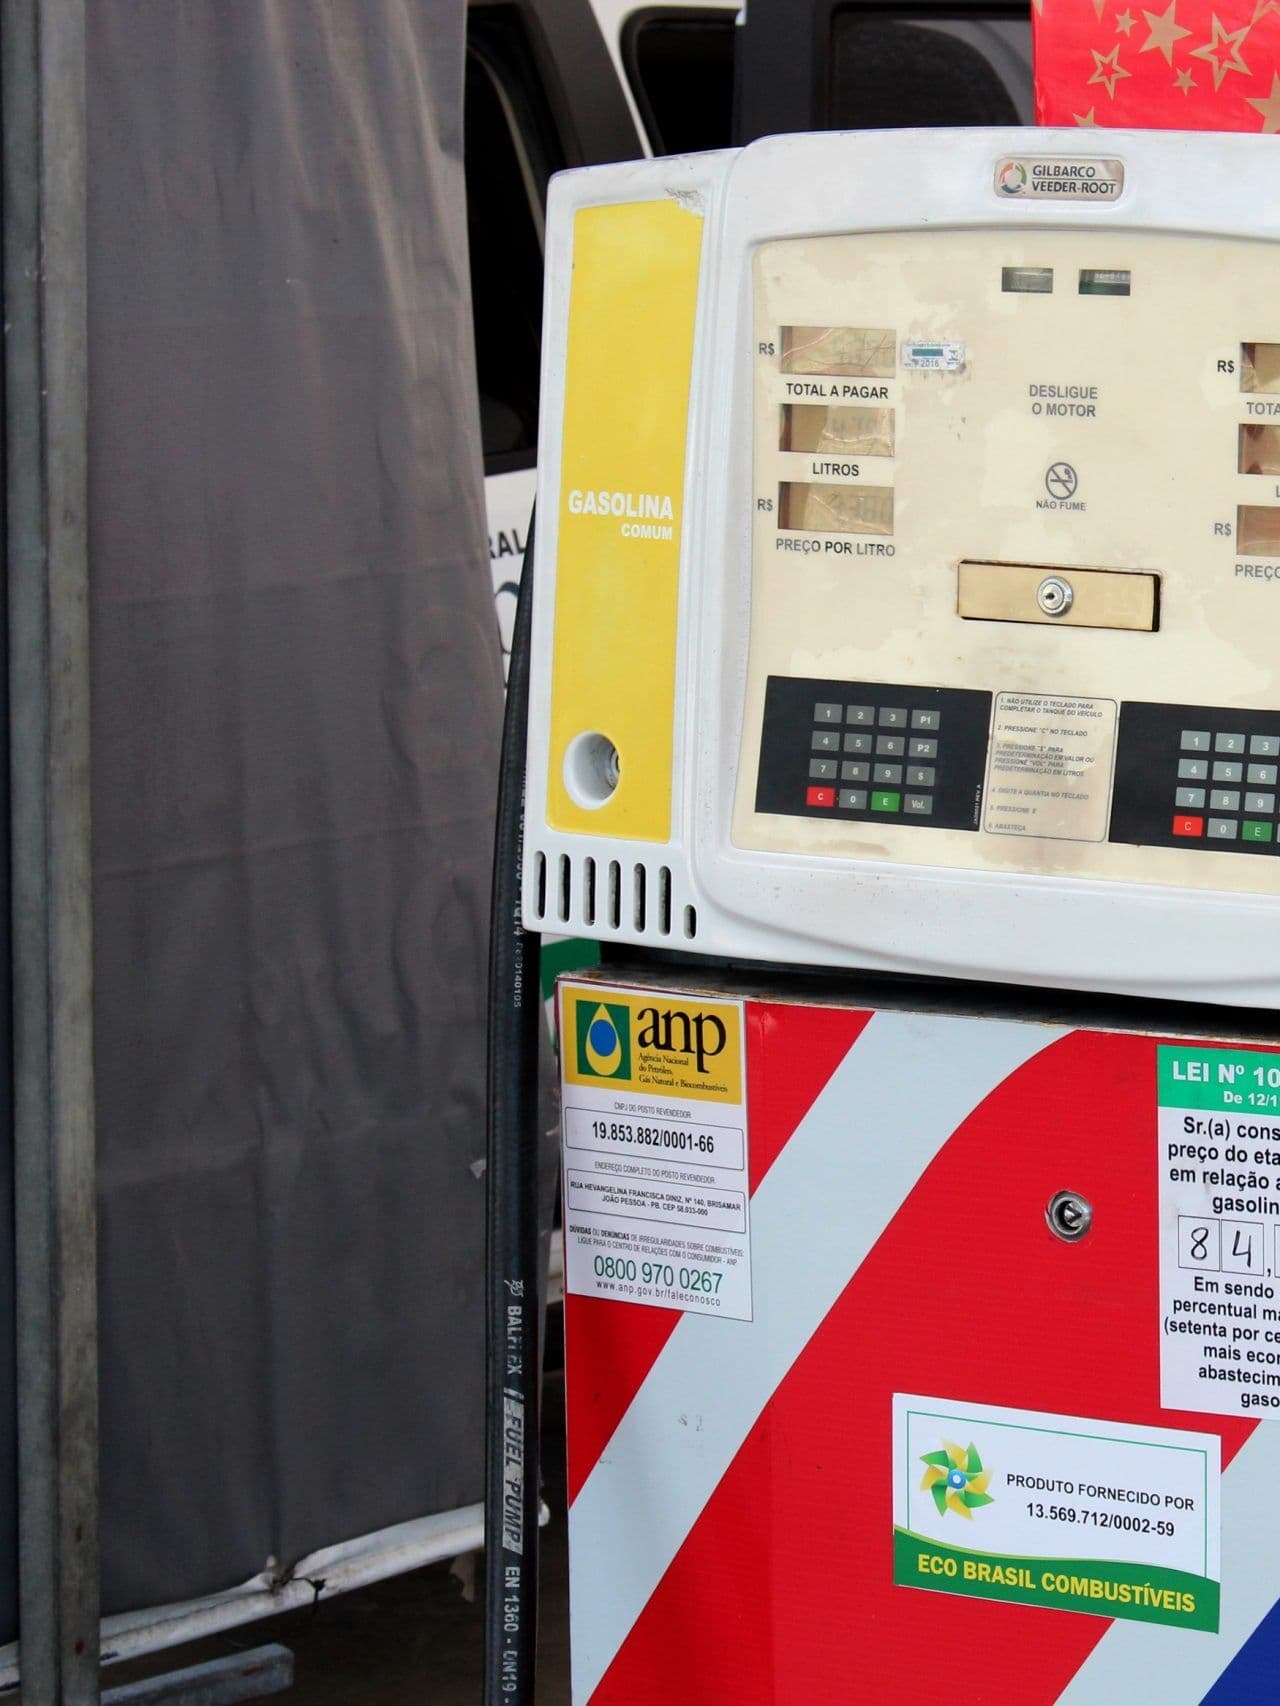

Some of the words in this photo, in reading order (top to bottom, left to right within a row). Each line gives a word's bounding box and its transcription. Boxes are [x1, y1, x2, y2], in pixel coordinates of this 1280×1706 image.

[1033, 165, 1095, 178] GILBARCO
[1032, 181, 1116, 194] VEEDER-ROOT
[759, 343, 775, 356] R$
[1217, 360, 1234, 373] R$
[786, 383, 826, 396] TOTAL
[830, 387, 839, 397] A
[843, 387, 888, 399] PAGAR
[1029, 384, 1098, 399] DESLIGUE
[1032, 403, 1042, 415] O
[1046, 403, 1096, 417] MOTOR
[812, 462, 859, 476] LITROS
[568, 490, 673, 520] GASOLINA
[758, 499, 773, 512] R$
[1060, 501, 1086, 511] FUME
[621, 523, 672, 540] COMUM
[1214, 523, 1231, 536] R$
[776, 538, 821, 555] PREÇO
[825, 541, 852, 554] POR
[856, 543, 895, 557] LITRO
[920, 716, 931, 724] P1
[918, 744, 930, 752] P2
[1228, 740, 1234, 748] 2
[1263, 742, 1269, 751] 3
[1191, 766, 1197, 774] 4
[1225, 768, 1231, 777] 5
[1260, 771, 1266, 779] 6
[883, 798, 888, 806] E
[1189, 794, 1194, 802] 7
[1223, 796, 1229, 805] 8
[1257, 799, 1263, 807] 9
[1185, 822, 1191, 830] C
[1255, 827, 1261, 836] E
[637, 1007, 727, 1074] anp
[1173, 1060, 1209, 1082] LEI
[1224, 1091, 1243, 1104] De
[592, 1121, 714, 1153] 19.853.882/0001-66
[1184, 1116, 1230, 1141] Sr.(a)
[1168, 1143, 1218, 1163] preço
[1225, 1145, 1248, 1162] do
[1170, 1168, 1196, 1183] em
[1203, 1169, 1269, 1191] relação
[570, 1181, 583, 1189] RUA
[585, 1183, 627, 1195] HEVANGELINA
[629, 1187, 665, 1200] FRANCISCA
[707, 1199, 741, 1211] BRISAMAR
[602, 1194, 618, 1203] JOÃO
[620, 1197, 646, 1208] PESSOA
[594, 1255, 636, 1280] 0800
[642, 1262, 674, 1287] 970
[680, 1268, 723, 1294] 0267
[596, 1280, 721, 1307] www.anp.gov.br/faleconosco
[1194, 1276, 1218, 1293] Em
[1225, 1281, 1274, 1299] sendo
[1174, 1299, 1256, 1319] percentual
[1164, 1317, 1226, 1337] (setenta
[1233, 1325, 1259, 1342] por
[1204, 1345, 1241, 1360] mais
[506, 1414, 522, 1467] FUEL
[1007, 1473, 1074, 1495] PRODUTO
[1078, 1483, 1161, 1507] FORNECIDO
[1165, 1495, 1194, 1512] POR
[505, 1479, 521, 1543] PUMP
[1027, 1502, 1175, 1537] 13.569.712/0002-59
[504, 1566, 520, 1588] EN
[917, 1553, 957, 1577] ECO
[964, 1559, 1036, 1589] BRASIL
[1041, 1572, 1196, 1613] COMBUSTÍVEIS
[504, 1595, 519, 1632] 1360
